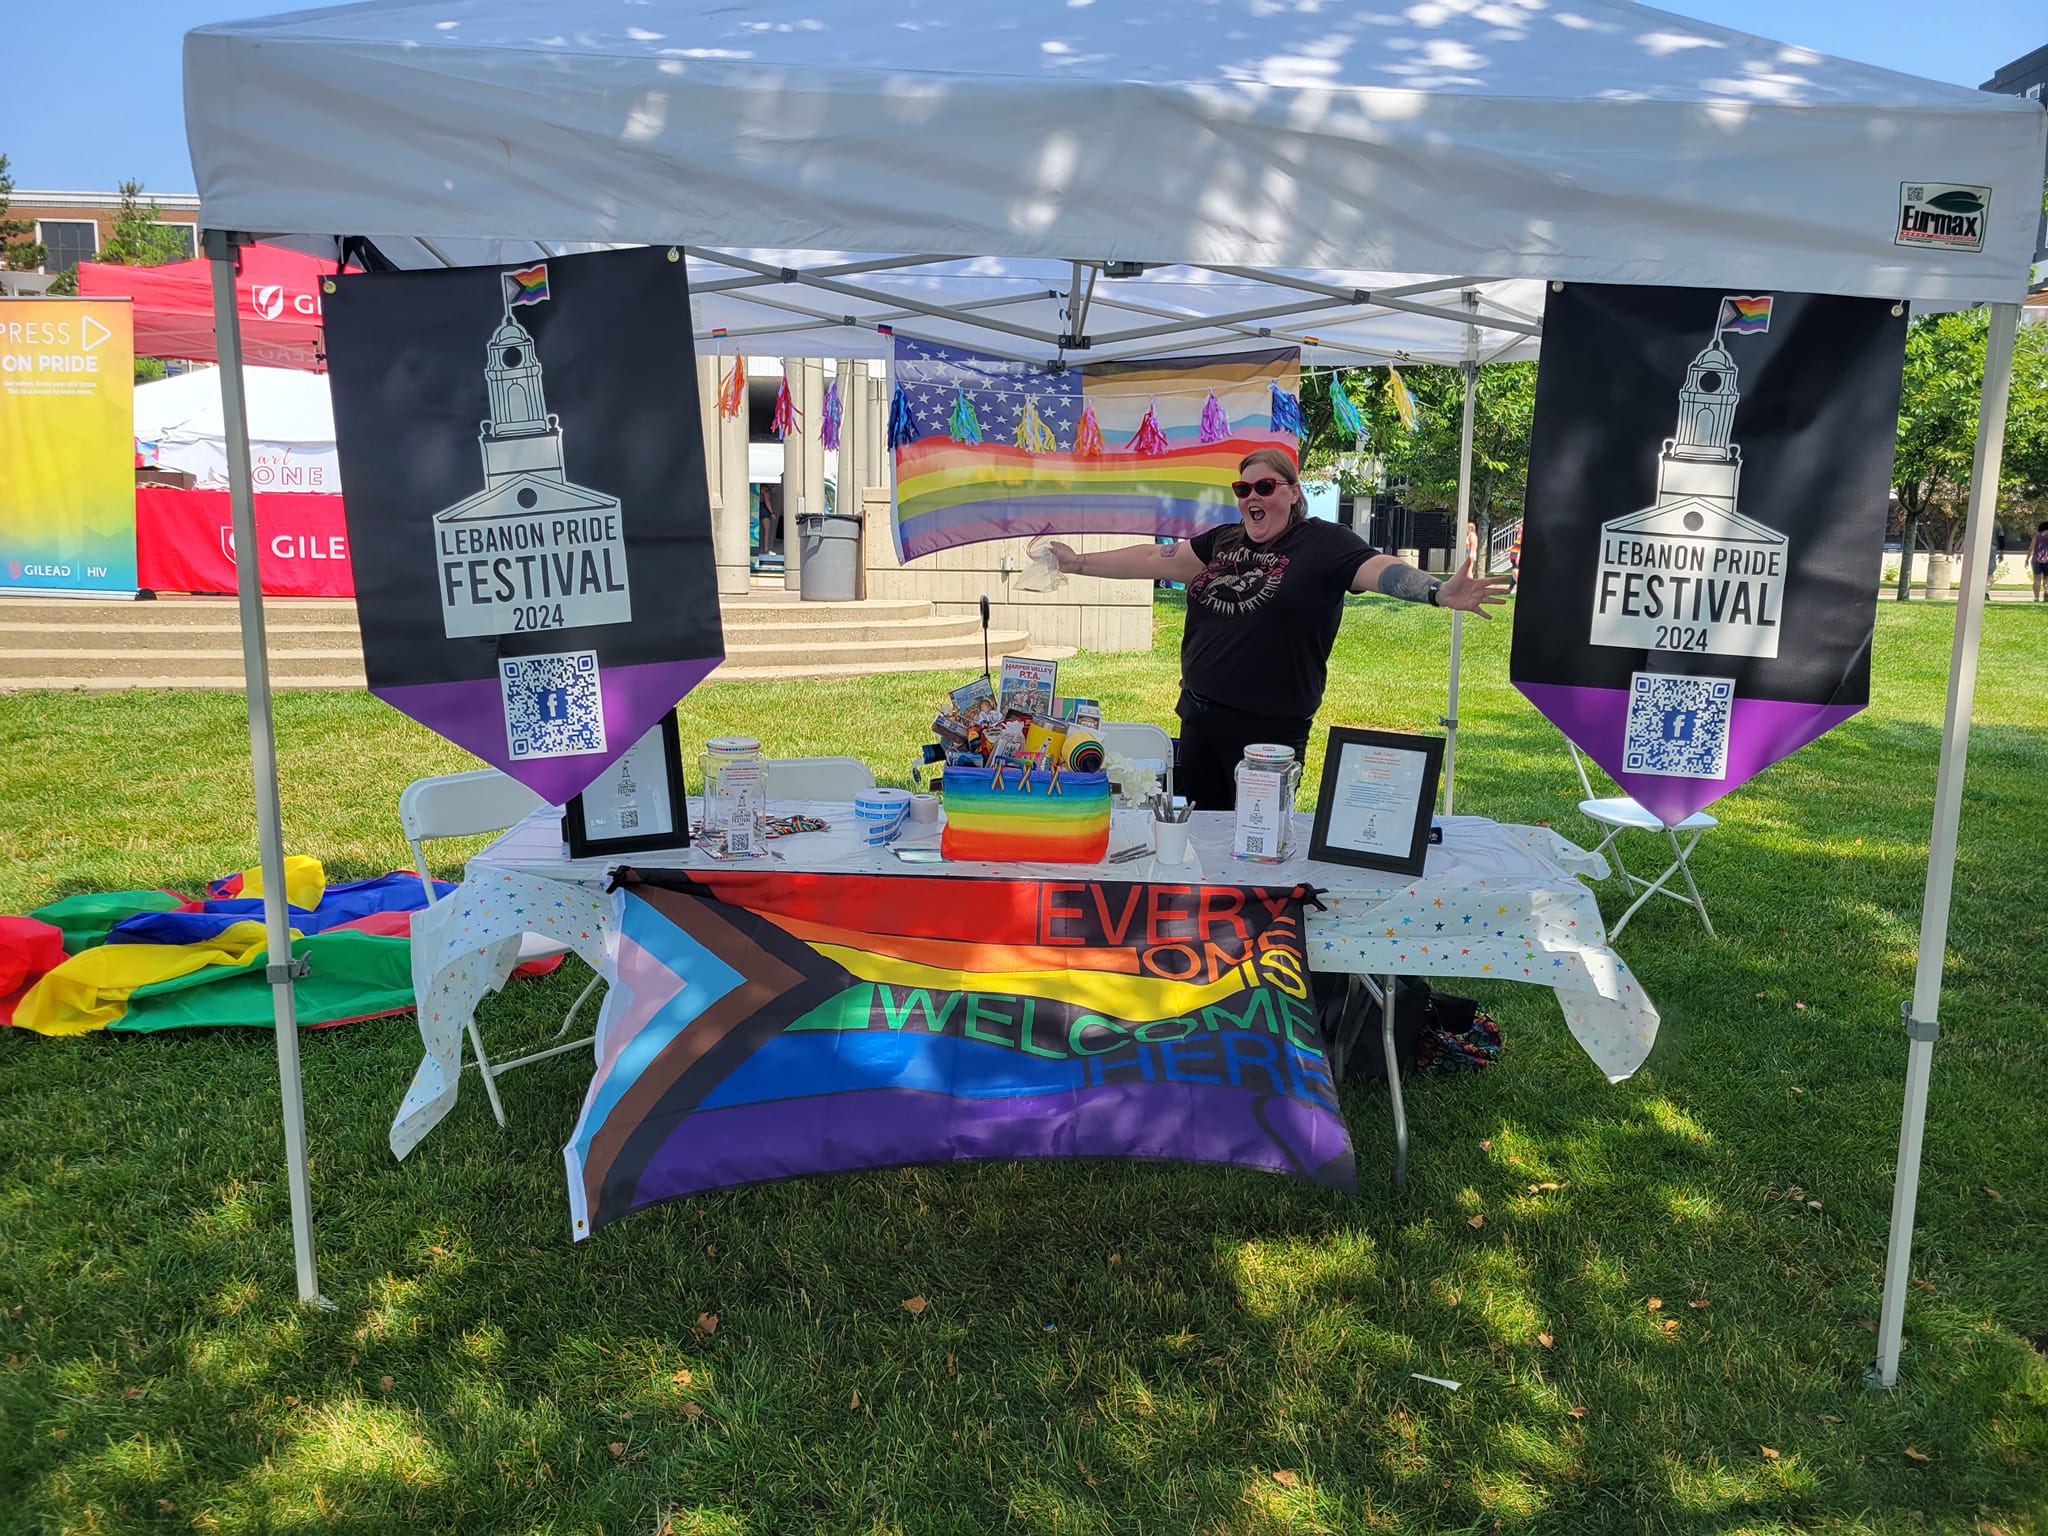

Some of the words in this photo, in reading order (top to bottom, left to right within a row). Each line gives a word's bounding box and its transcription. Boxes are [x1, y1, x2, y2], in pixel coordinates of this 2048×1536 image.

[1901, 205, 1978, 237] Eurmax
[2, 354, 33, 373] ON
[38, 354, 99, 373] PRIDE
[440, 522, 545, 556] LEBANON
[552, 515, 617, 546] PRIDE
[24, 565, 71, 577] GILEAD
[87, 566, 108, 578] HIV
[443, 548, 625, 607] FESTIVAL
[1604, 539, 1705, 572] LEBANON
[1713, 548, 1781, 577] PRIDE
[512, 604, 565, 631] 2024
[1206, 594, 1235, 615] THIN
[1598, 571, 1776, 627] FESTIVAL
[1655, 625, 1708, 652] 2024
[1040, 883, 1305, 945] EVERY
[1142, 916, 1303, 983] ONE
[1241, 949, 1307, 1000] IS
[876, 985, 1324, 1060] WELCOME
[1091, 1031, 1339, 1113] HERE
